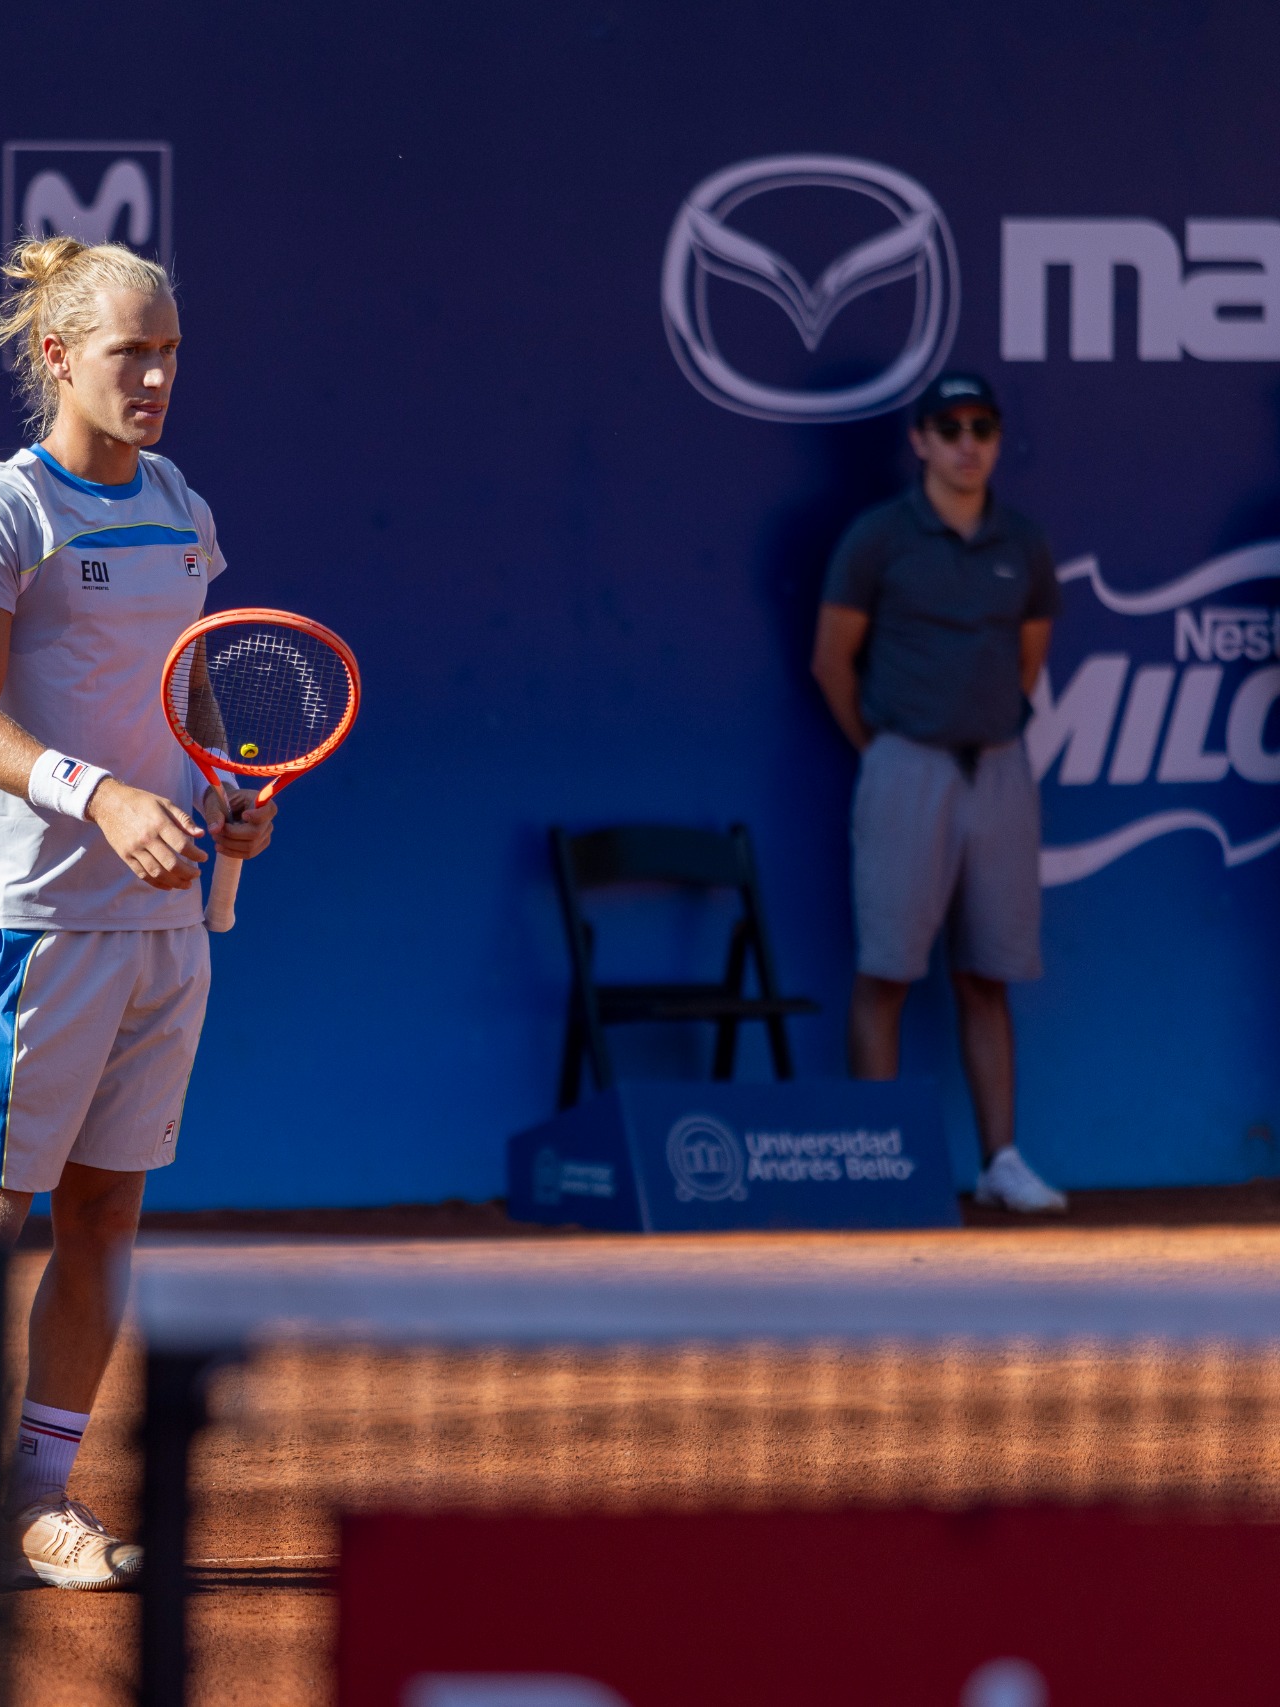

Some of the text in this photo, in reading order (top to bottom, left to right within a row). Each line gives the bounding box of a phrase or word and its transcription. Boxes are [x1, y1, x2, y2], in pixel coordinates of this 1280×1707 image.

[1001, 217, 1280, 362] ma
[81, 560, 110, 583] EQI
[1175, 608, 1280, 662] Nes
[745, 1130, 901, 1157] Universidad
